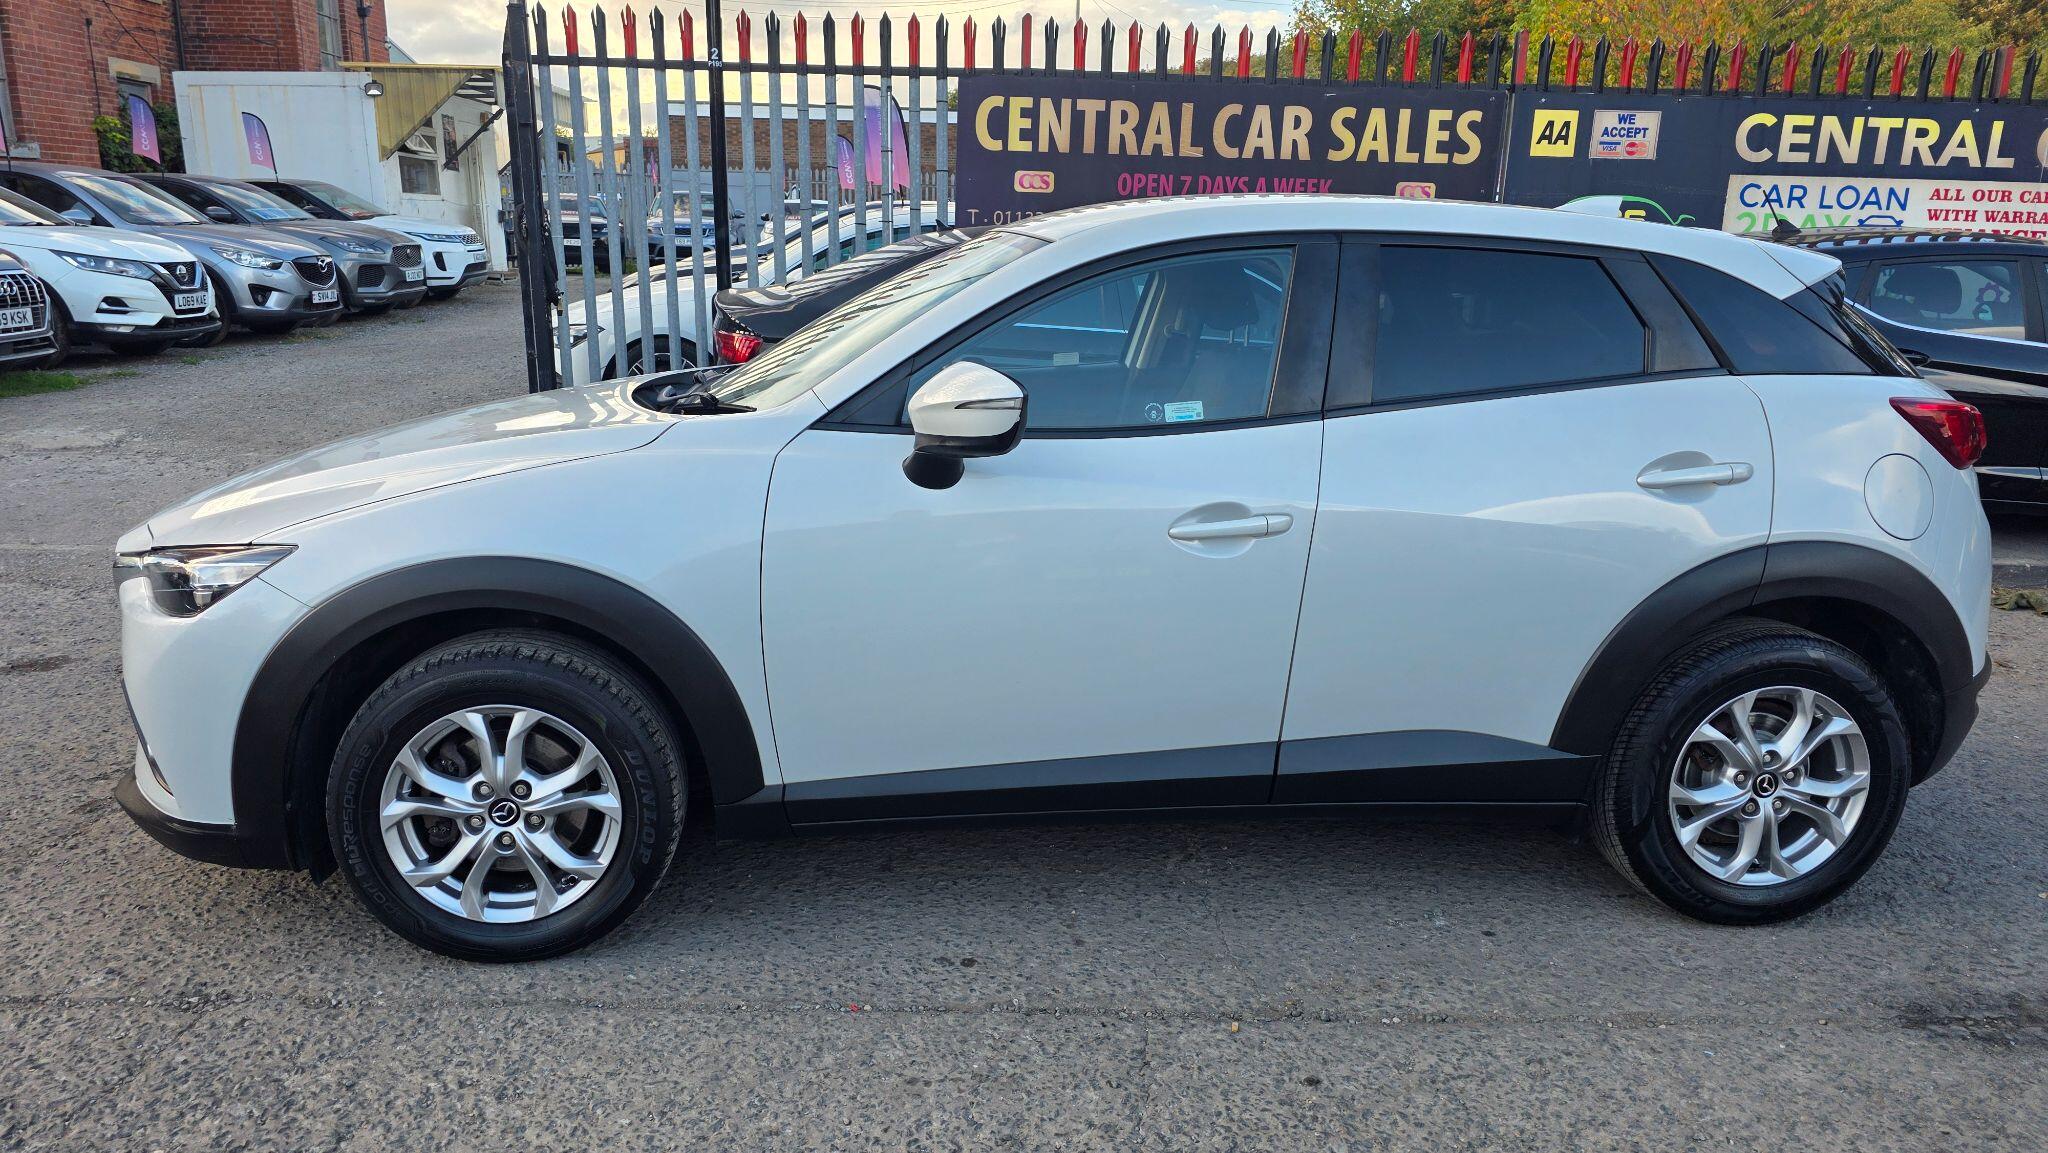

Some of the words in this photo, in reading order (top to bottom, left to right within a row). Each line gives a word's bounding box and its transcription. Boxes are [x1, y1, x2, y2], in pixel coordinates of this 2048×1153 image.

[711, 47, 719, 60] 2
[1617, 113, 1637, 125] WE
[975, 95, 1204, 157] CENTRAL
[1212, 103, 1314, 161] CAR
[1327, 106, 1485, 165] SALES
[1536, 119, 1572, 146] AA
[1601, 126, 1649, 139] ACCEPT
[1734, 113, 2015, 169] CENTRAL
[1117, 172, 1173, 197] OPEN
[1180, 175, 1193, 195] 7
[1197, 175, 1249, 194] DAYS
[1255, 177, 1267, 193] A
[1273, 177, 1333, 194] WEEK
[1739, 182, 1808, 209] CAR
[1818, 185, 1910, 211] LOAN
[1929, 188, 1966, 201] ALL
[1972, 189, 2013, 203] OUR
[1927, 208, 1979, 223] WITH
[10, 310, 29, 325] KSK
[624, 748, 658, 865] DUNLOP
